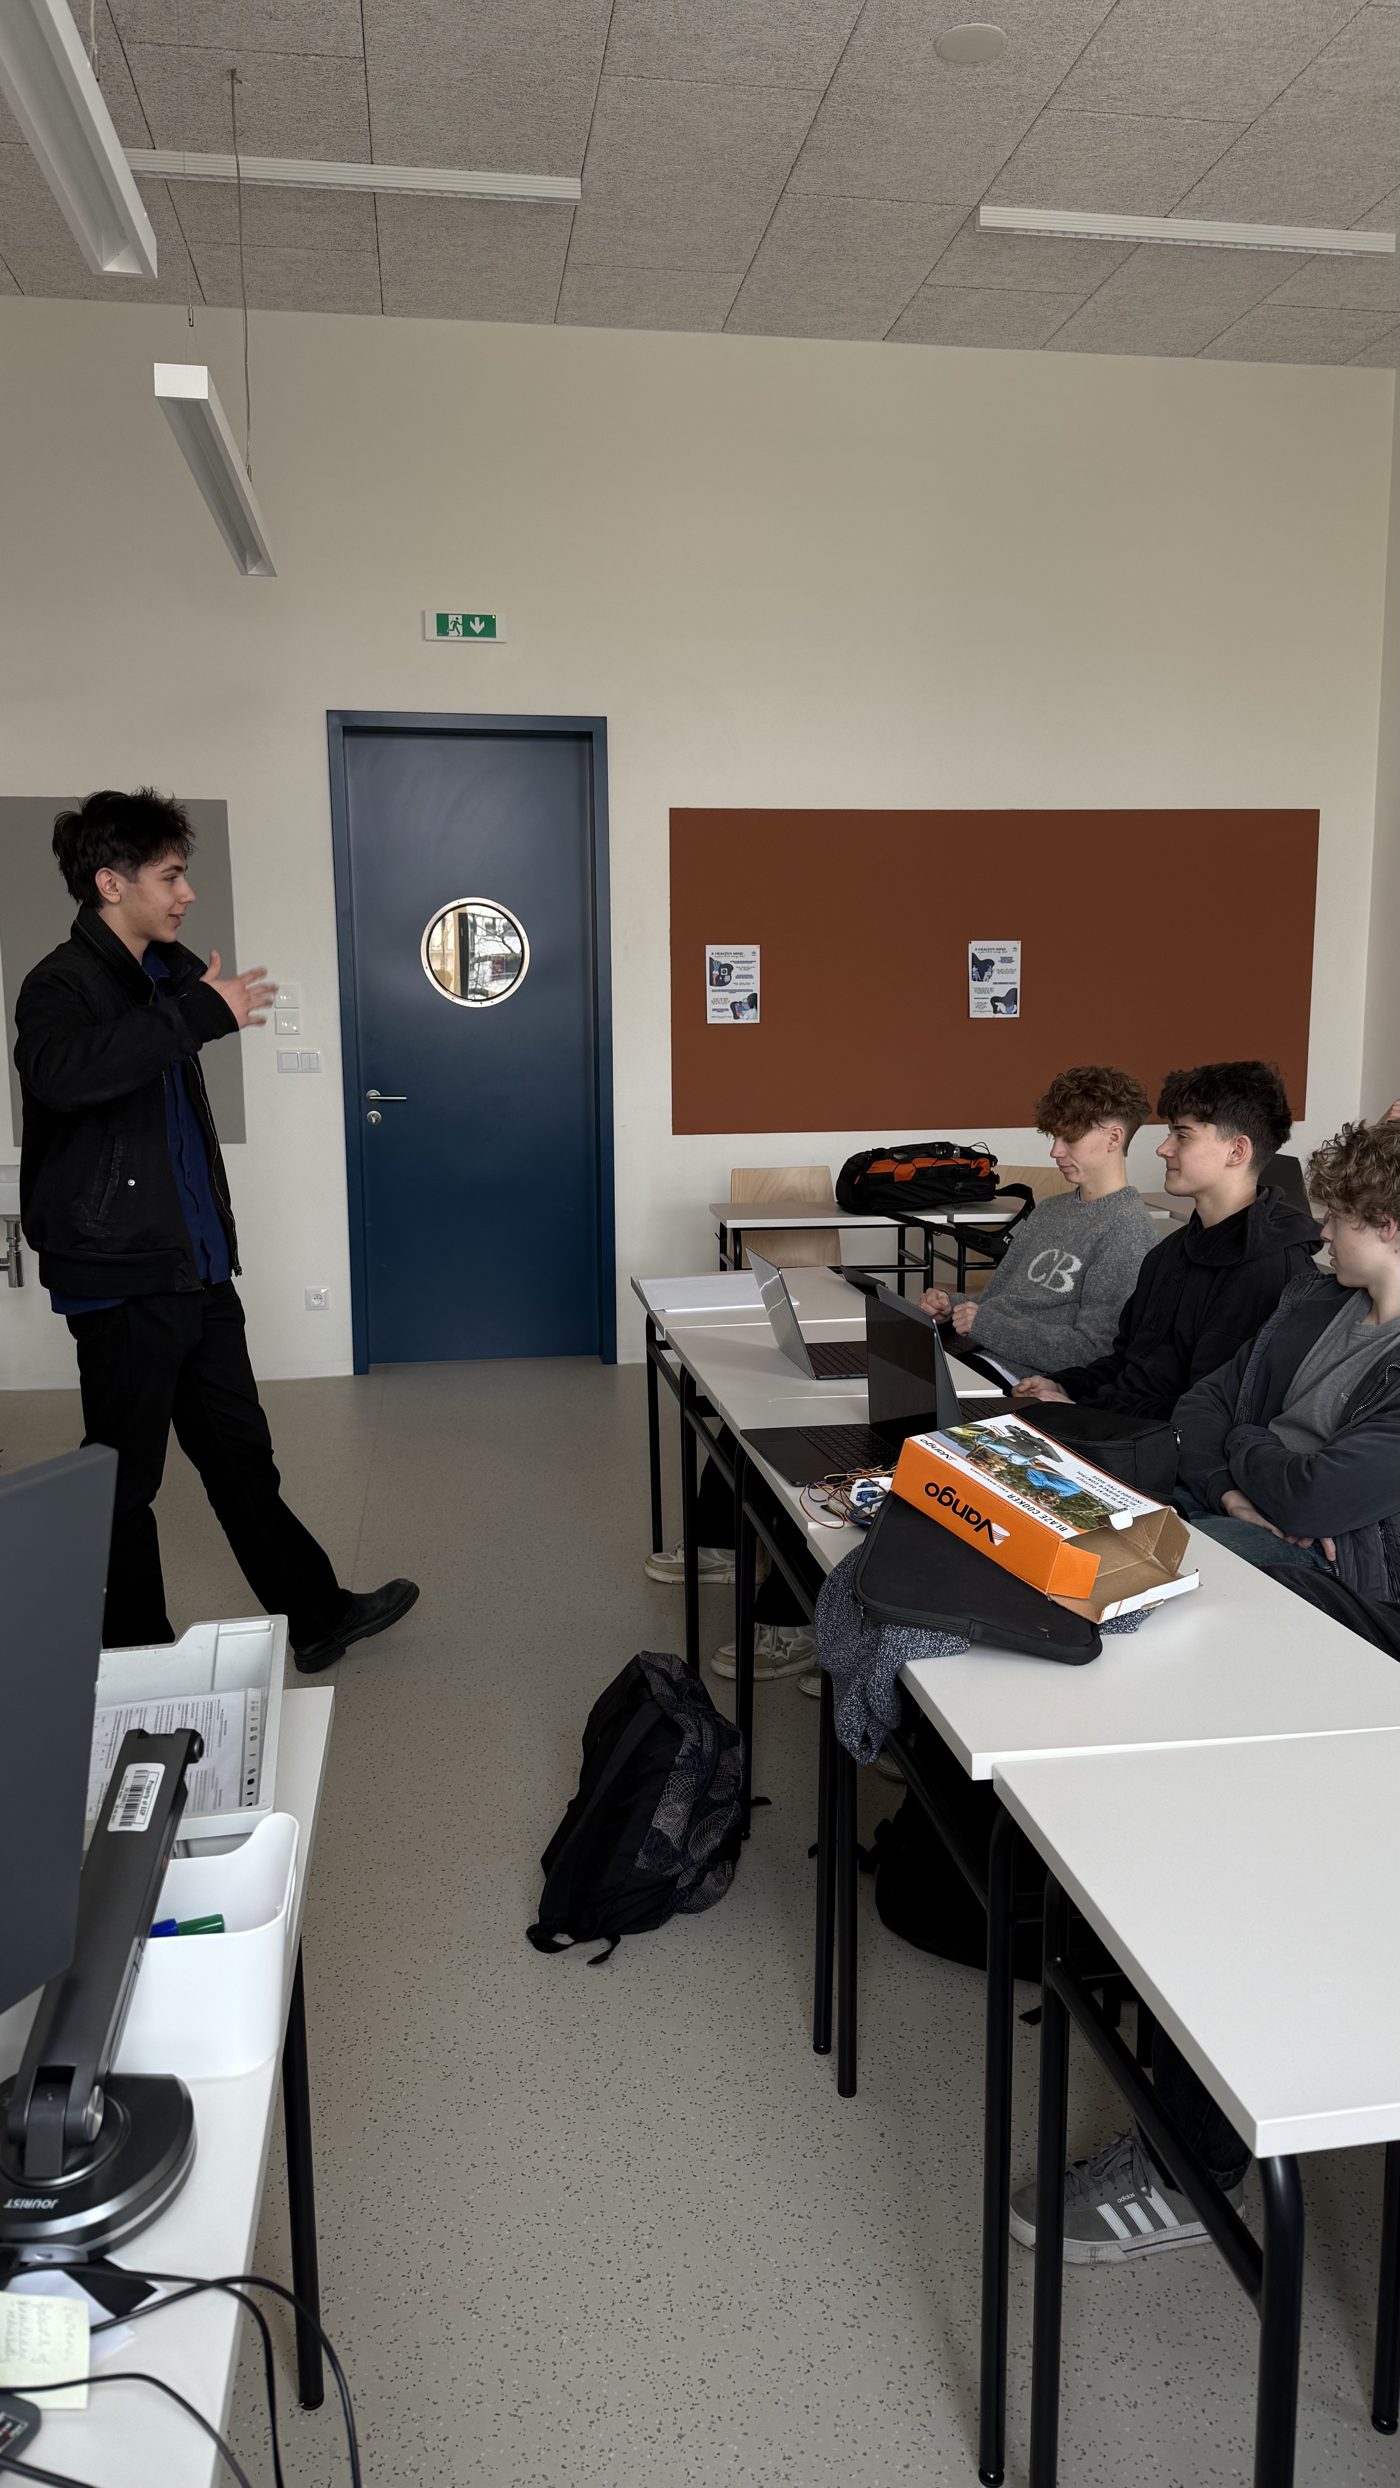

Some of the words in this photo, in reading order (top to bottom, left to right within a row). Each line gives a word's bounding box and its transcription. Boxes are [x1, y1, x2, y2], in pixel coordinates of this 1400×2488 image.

[1028, 1249, 1082, 1293] CB
[920, 1438, 953, 1460] Vango
[924, 1482, 995, 1544] Vango
[1007, 1493, 1038, 1515] COOKER
[1038, 1514, 1068, 1532] BLAZE
[3, 2198, 59, 2209] JOURIST
[1117, 2192, 1135, 2203] adidas
